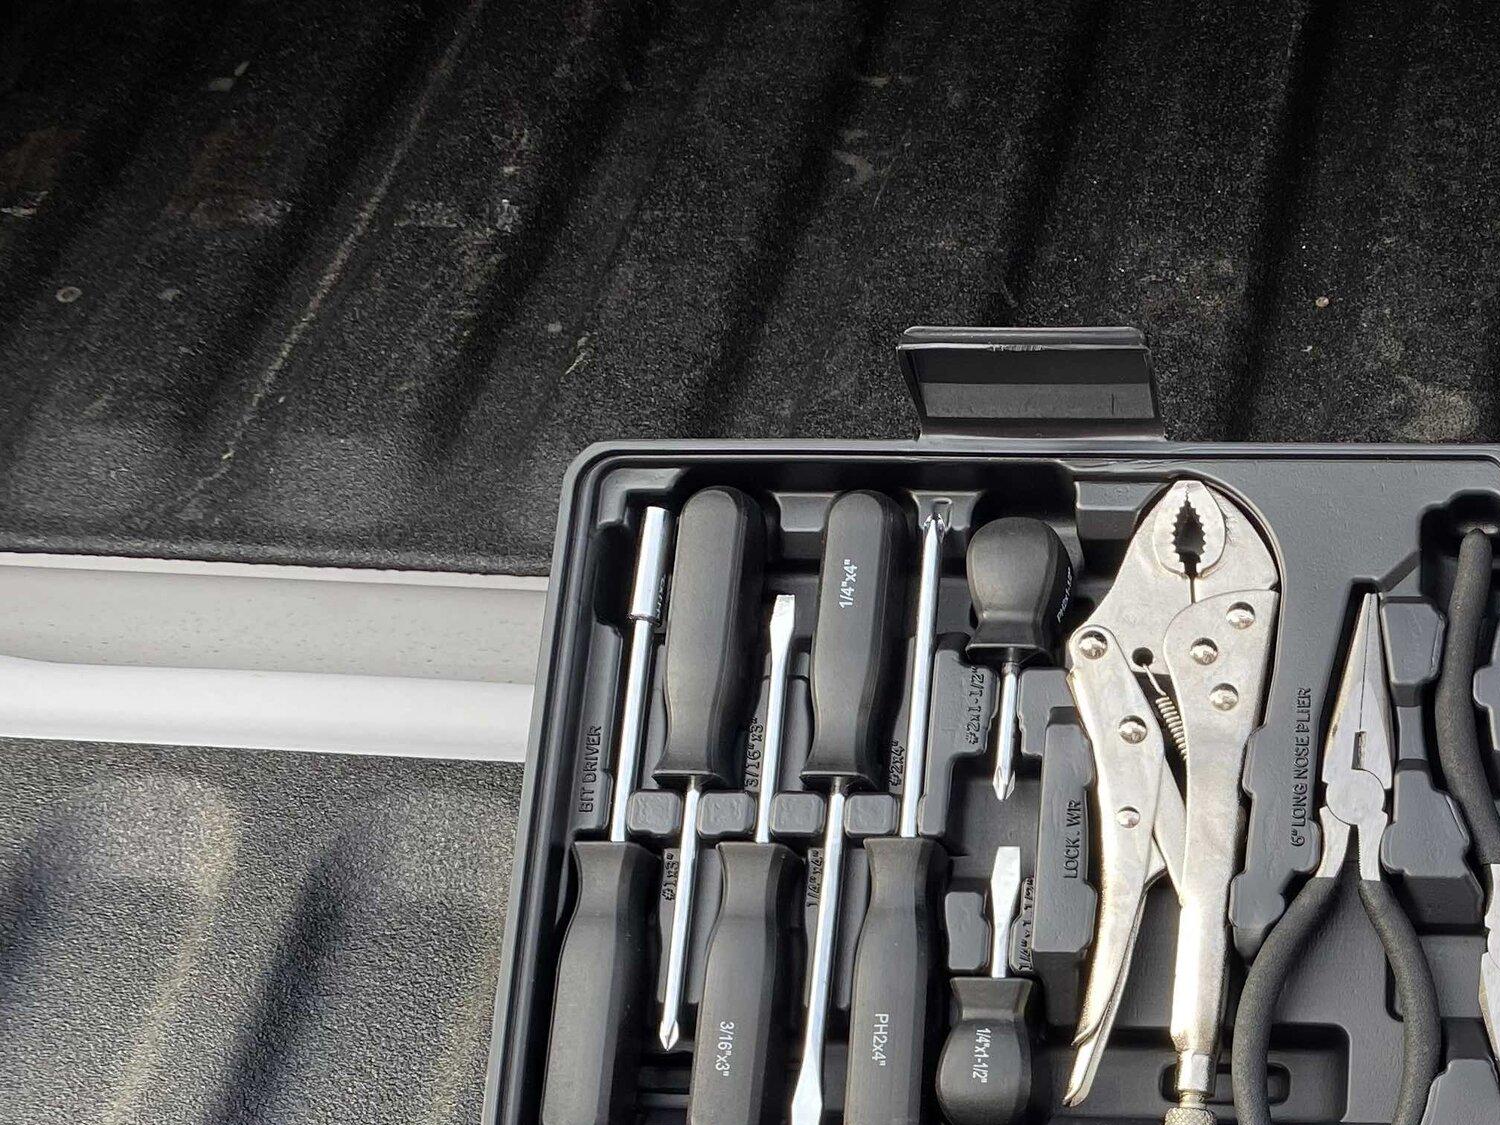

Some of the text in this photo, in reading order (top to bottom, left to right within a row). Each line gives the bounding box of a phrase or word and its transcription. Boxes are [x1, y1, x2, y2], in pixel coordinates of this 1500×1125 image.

[839, 558, 858, 609] 1/4"x4"
[1295, 687, 1311, 732] PLIER
[579, 726, 602, 812] BIT DRIVER
[1294, 736, 1310, 780] NOSE
[1066, 800, 1081, 827] WR
[1292, 783, 1308, 827] LONG
[719, 1021, 735, 1078] 3/16"x3"
[873, 1013, 890, 1067] PH2x4"
[972, 1028, 991, 1084] 1/4"x1-1/2"
